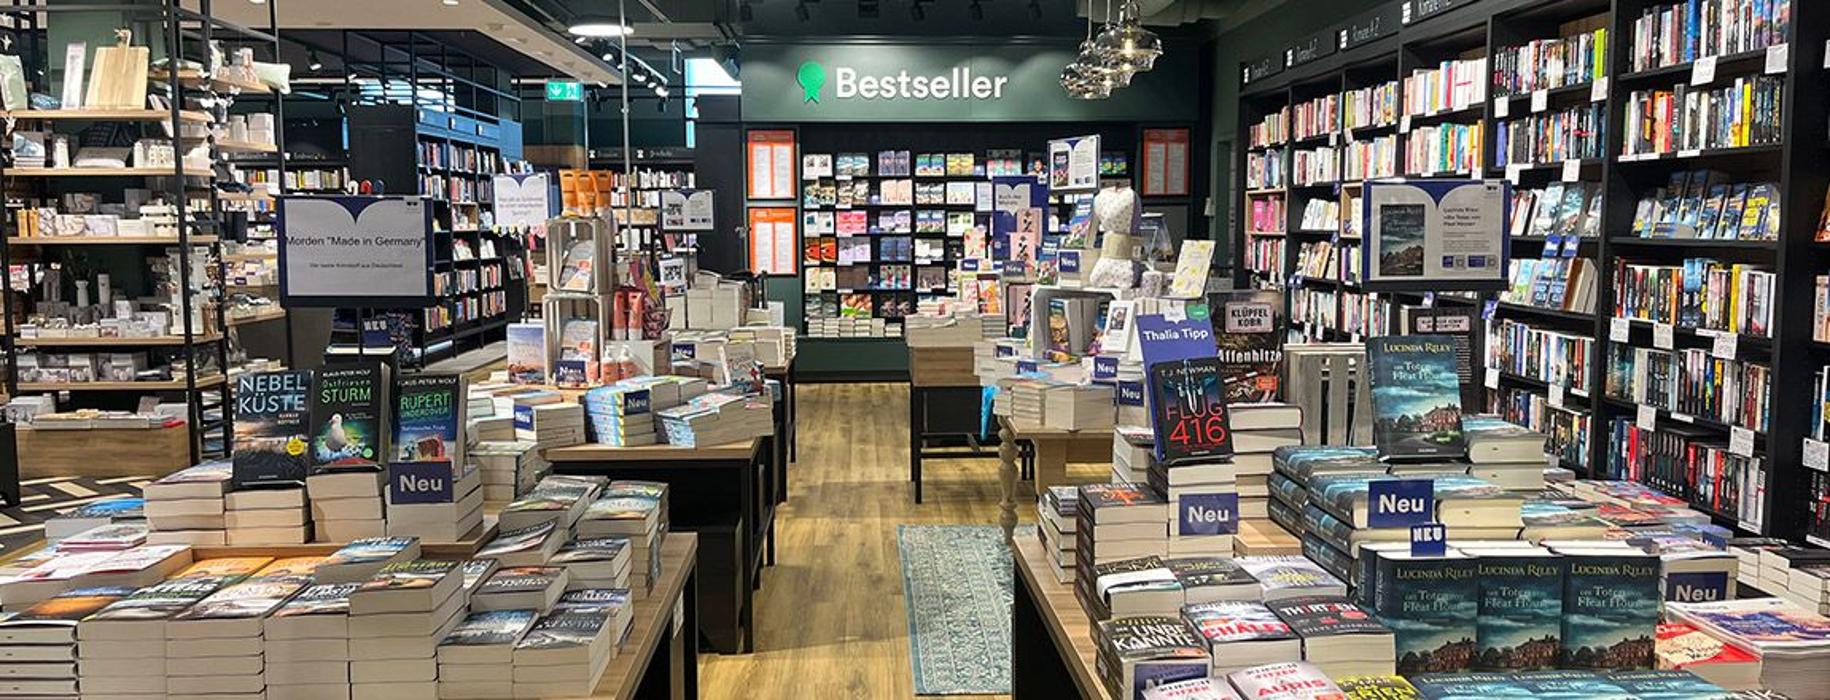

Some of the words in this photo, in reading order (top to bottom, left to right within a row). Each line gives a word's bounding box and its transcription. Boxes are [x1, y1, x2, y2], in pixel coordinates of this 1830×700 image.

[836, 67, 1008, 99] Bestseller
[286, 236, 325, 246] Morden
[327, 236, 361, 246] "Made
[362, 236, 372, 246] in
[1061, 257, 1077, 267] Neu
[1232, 306, 1268, 318] KLÜPFEL
[1143, 328, 1180, 341] Thalia
[1181, 328, 1209, 339] Tipp
[560, 366, 582, 377] Neu
[1097, 363, 1115, 373] Neu
[240, 374, 306, 393] NEBEL
[322, 388, 371, 403] STURM
[400, 393, 450, 410] RUPERT
[1122, 388, 1140, 400] Neu
[239, 393, 306, 414] KÜSTE
[628, 399, 647, 409] Neu
[1167, 401, 1224, 420] FLUG
[1169, 416, 1226, 445] 416
[400, 475, 443, 492] Neu
[1379, 493, 1425, 514] Neu
[1188, 506, 1229, 523] Neu
[1413, 527, 1442, 542] NEU
[1396, 567, 1442, 579] LUCINDA
[1444, 567, 1473, 580] RILEY
[1478, 564, 1524, 575] LUCINDA
[1527, 564, 1558, 576] RILEY
[1571, 563, 1620, 575] LUCINDA
[1622, 564, 1654, 577] RILEY
[1675, 585, 1717, 600] Neu
[1258, 678, 1327, 697] AURIS
